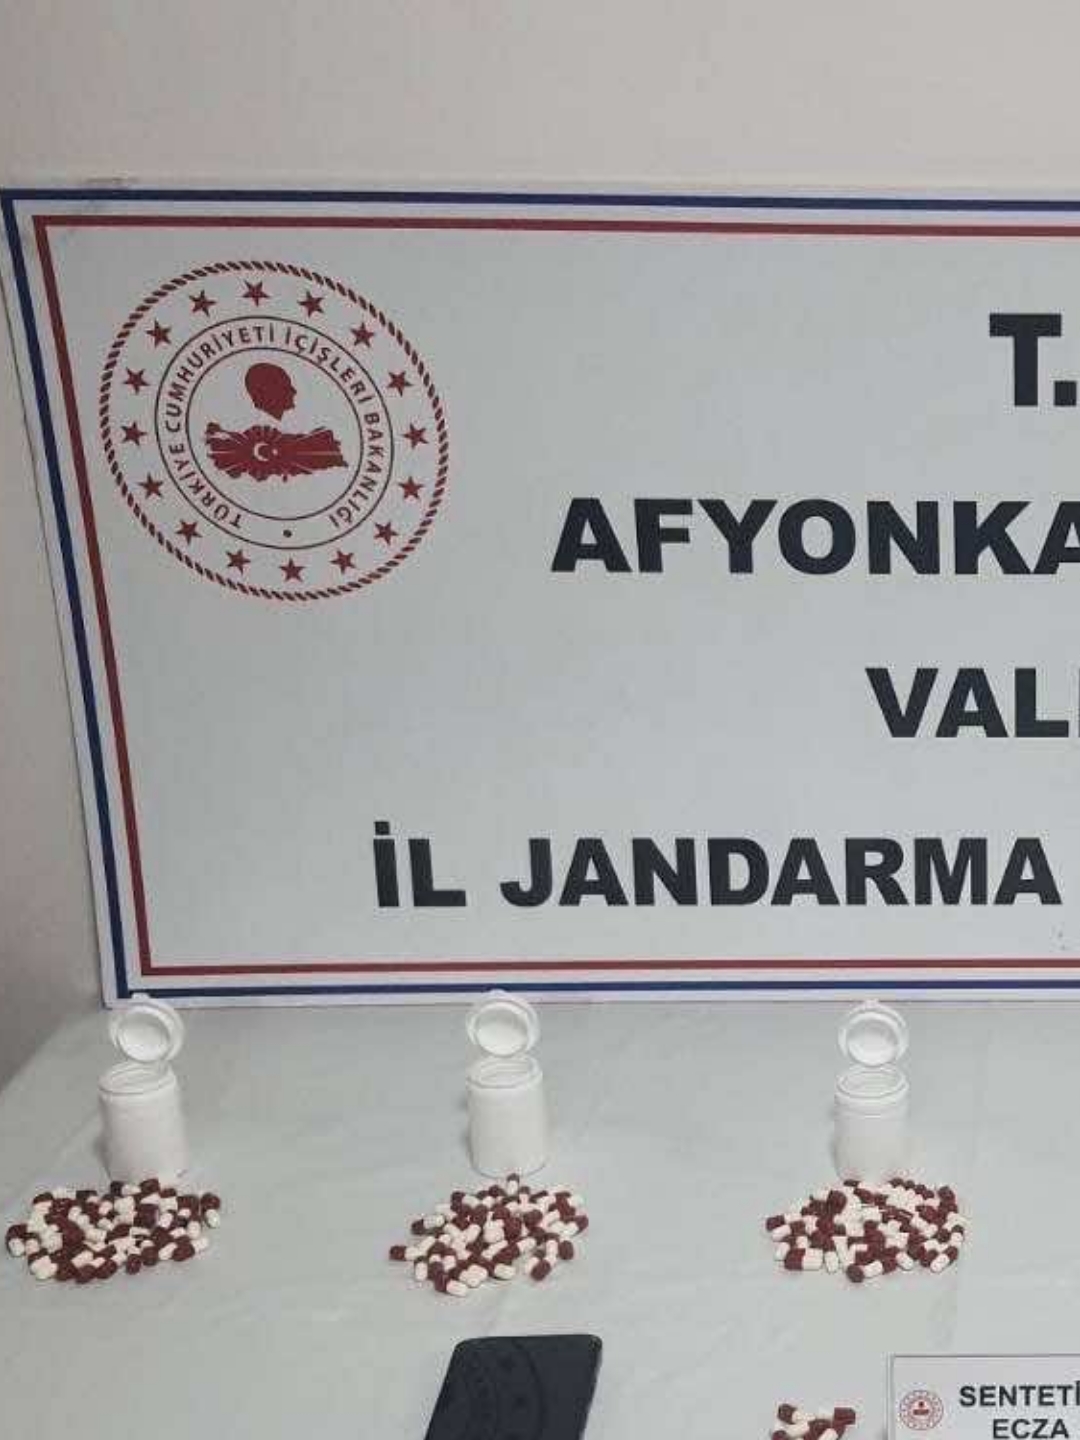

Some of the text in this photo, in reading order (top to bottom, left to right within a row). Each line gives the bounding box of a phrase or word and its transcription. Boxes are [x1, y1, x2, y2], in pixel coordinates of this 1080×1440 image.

[164, 322, 385, 529] TÜRKİYE CUMHURİYETİ İÇİŞLERİ BAKANLIĞI
[373, 820, 467, 908] İL
[499, 837, 1062, 907] JANDARMA
[992, 1418, 1071, 1440] ECZA
